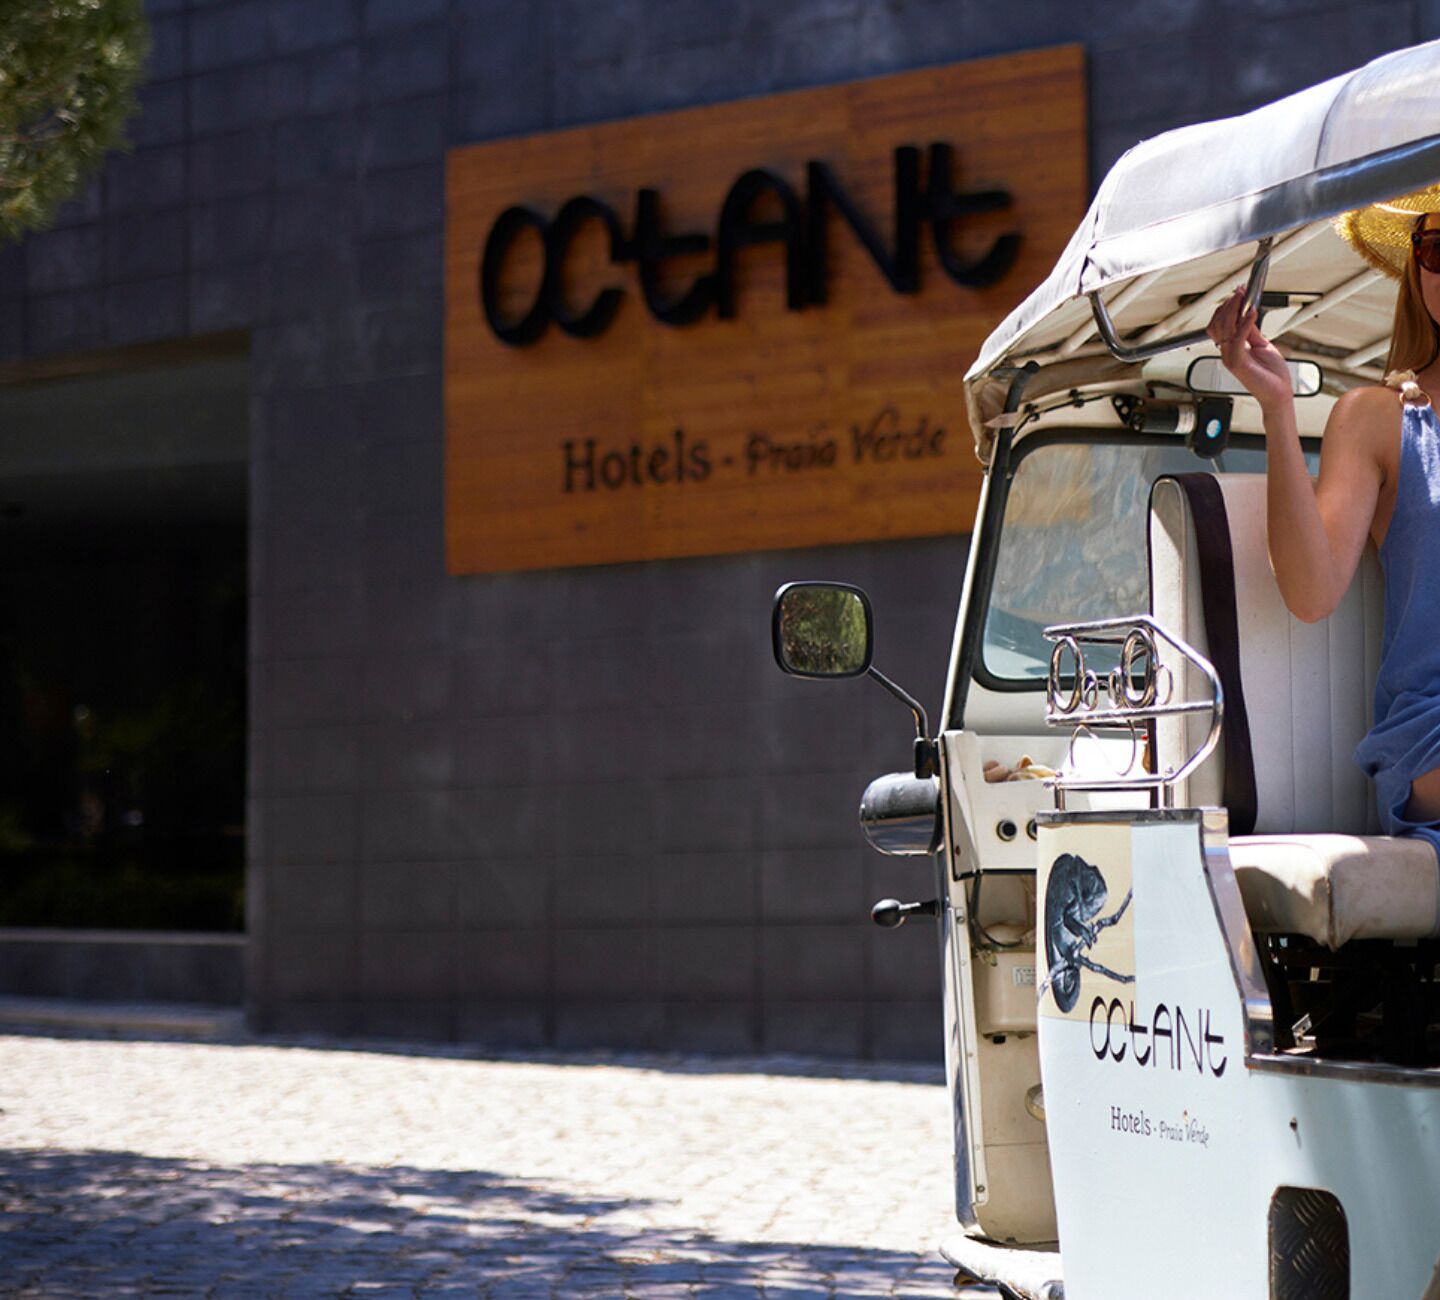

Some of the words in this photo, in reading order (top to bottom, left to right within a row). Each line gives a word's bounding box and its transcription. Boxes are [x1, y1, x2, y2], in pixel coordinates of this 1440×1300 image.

[561, 427, 713, 494] Hotels
[849, 403, 947, 464] Verde
[1110, 1105, 1151, 1136] Hotels
[1159, 1119, 1183, 1142] Praia
[1185, 1117, 1210, 1149] Verde
